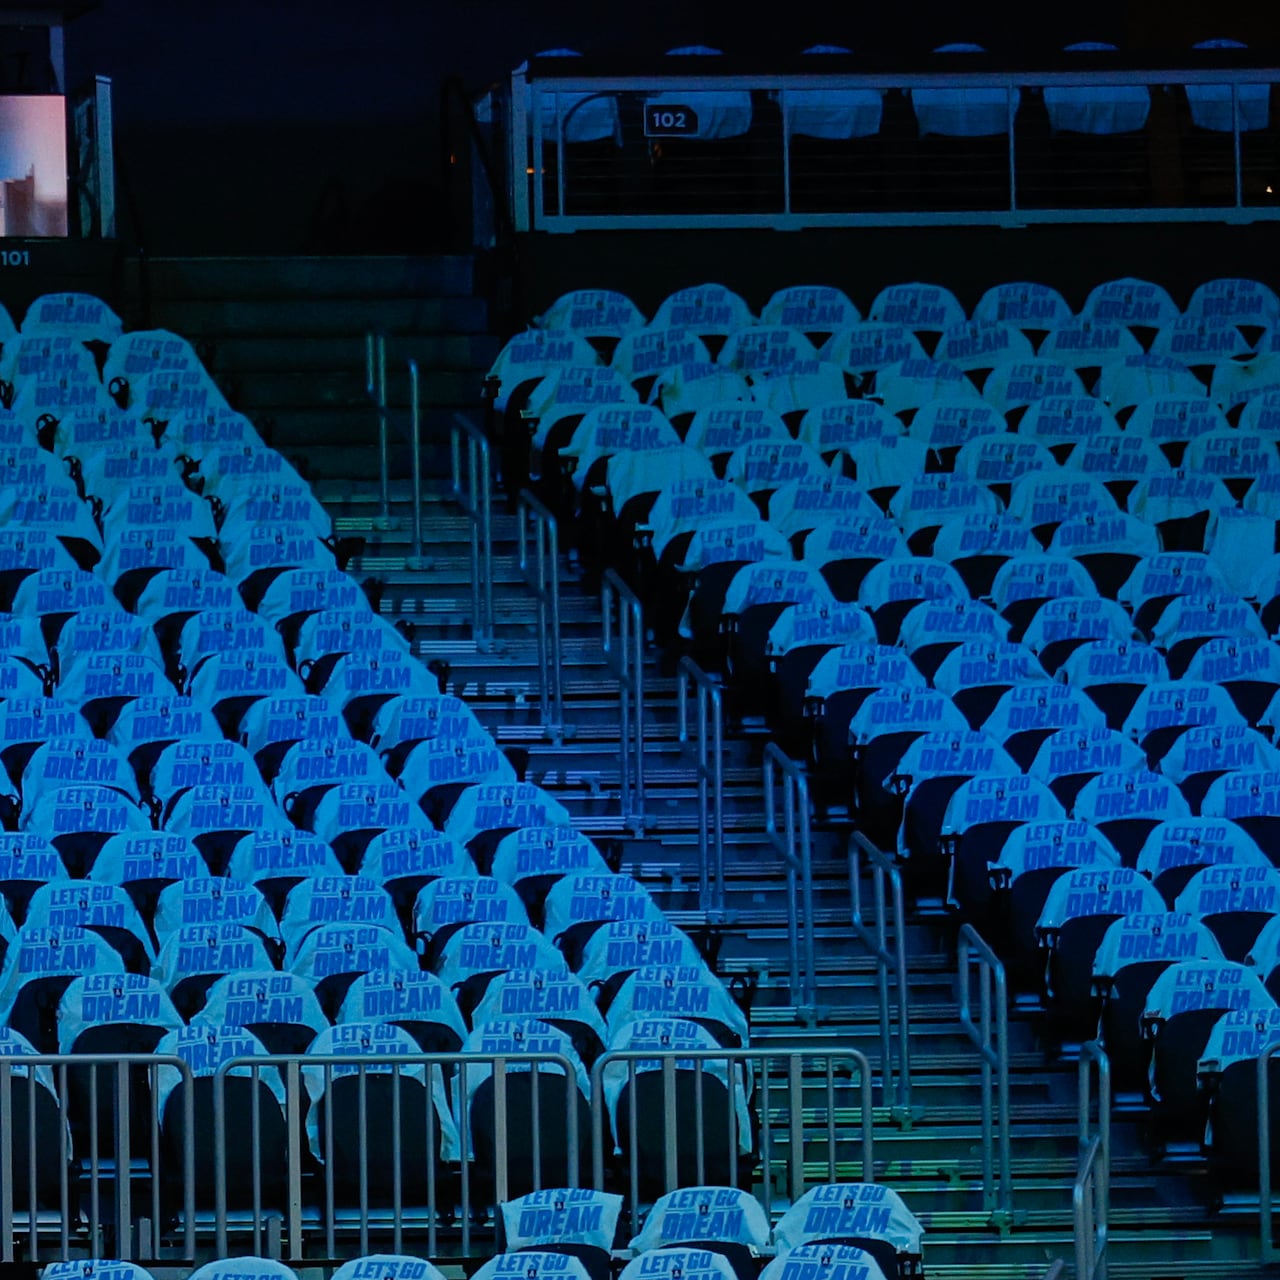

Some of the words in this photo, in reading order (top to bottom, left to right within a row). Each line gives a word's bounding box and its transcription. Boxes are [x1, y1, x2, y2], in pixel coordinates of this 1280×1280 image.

[653, 112, 686, 128] 102
[1, 250, 29, 266] 101
[1009, 703, 1079, 729] DREAM
[1026, 823, 1063, 841] LET'S
[1066, 821, 1088, 838] GO
[164, 837, 187, 853] GO
[1024, 841, 1097, 870] DREAM
[124, 857, 197, 881] DREAM
[1070, 870, 1110, 888] LET'S
[1112, 869, 1134, 885] GO
[1066, 889, 1144, 915] DREAM
[1166, 913, 1189, 928] GO
[317, 931, 355, 946] LET'S
[356, 929, 378, 944] GO
[464, 925, 503, 940] LET'S
[505, 923, 527, 939] GO
[1119, 933, 1198, 959] DREAM
[459, 944, 537, 969] DREAM
[632, 986, 709, 1012] DREAM
[632, 1021, 671, 1036] LET'S
[673, 1020, 697, 1036] GO
[496, 1254, 541, 1272] LET'S
[542, 1253, 569, 1270] GO
